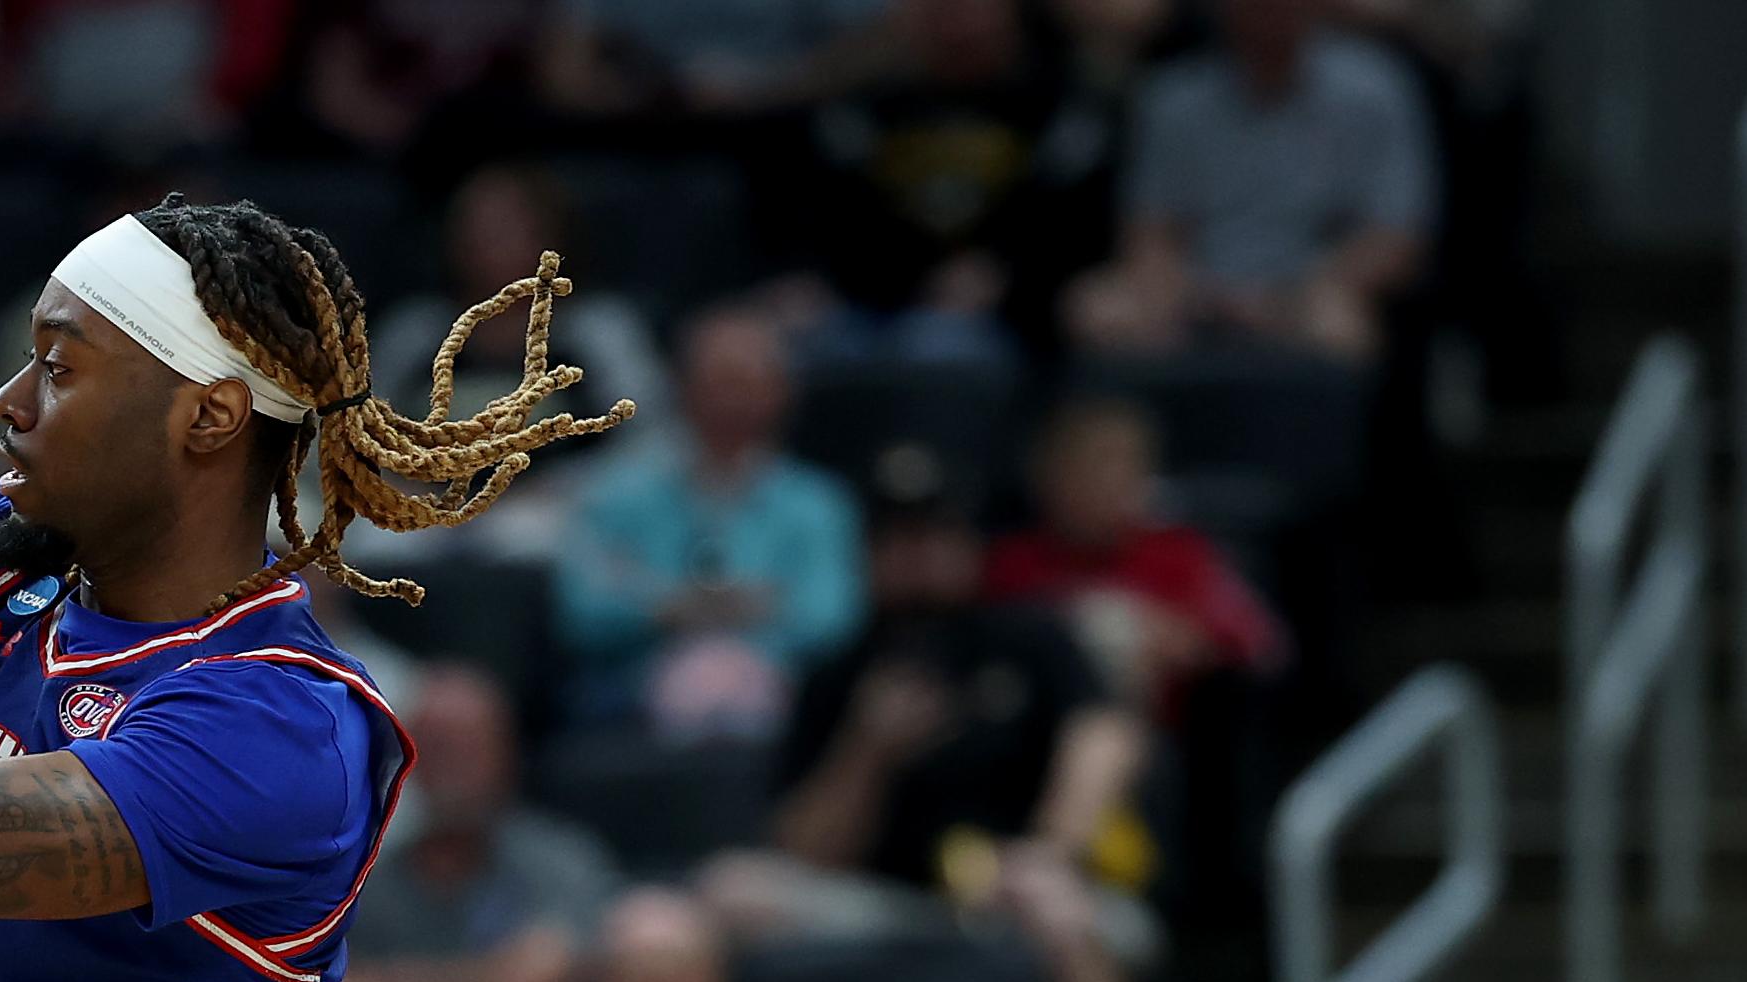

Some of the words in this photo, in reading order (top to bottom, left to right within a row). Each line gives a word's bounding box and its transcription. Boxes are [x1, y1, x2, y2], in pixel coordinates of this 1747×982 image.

[91, 291, 127, 321] UNDER
[126, 320, 175, 359] ARMOUR
[12, 588, 49, 610] NCAA
